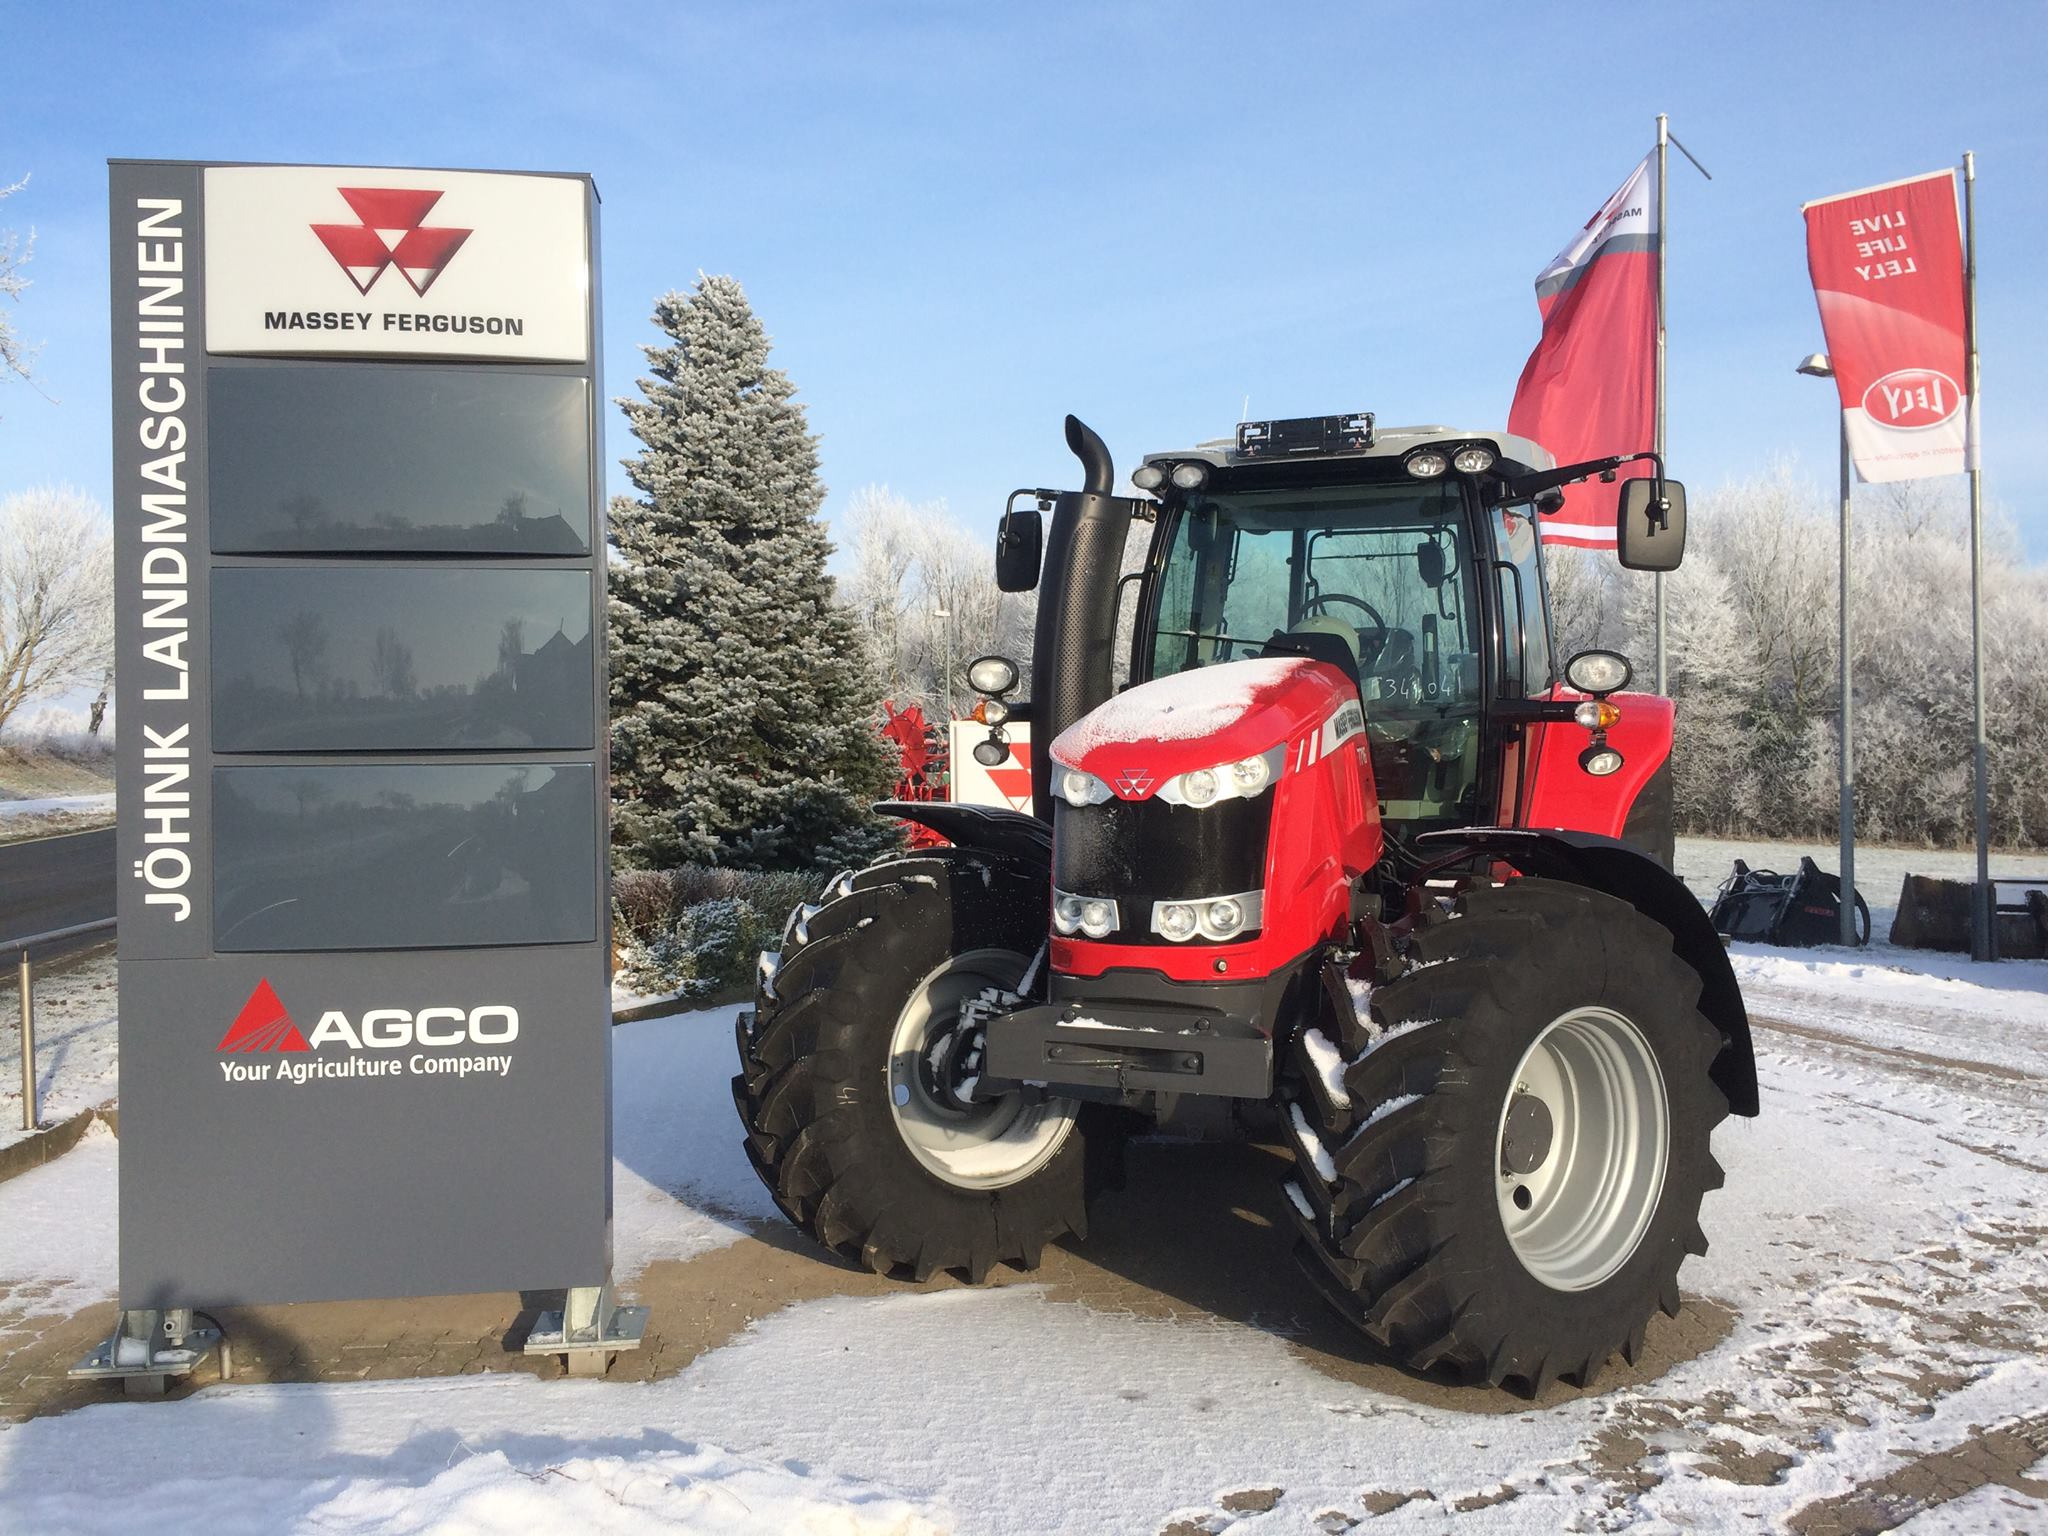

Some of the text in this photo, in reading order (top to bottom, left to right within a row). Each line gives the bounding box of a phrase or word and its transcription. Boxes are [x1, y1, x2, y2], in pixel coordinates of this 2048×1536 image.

[264, 311, 524, 336] MASSEY FERGUSON
[133, 198, 192, 922] JÖHNK LANDMASCHINEN
[308, 1005, 520, 1051] AGCO
[219, 1053, 513, 1085] Your Agriculture Company
